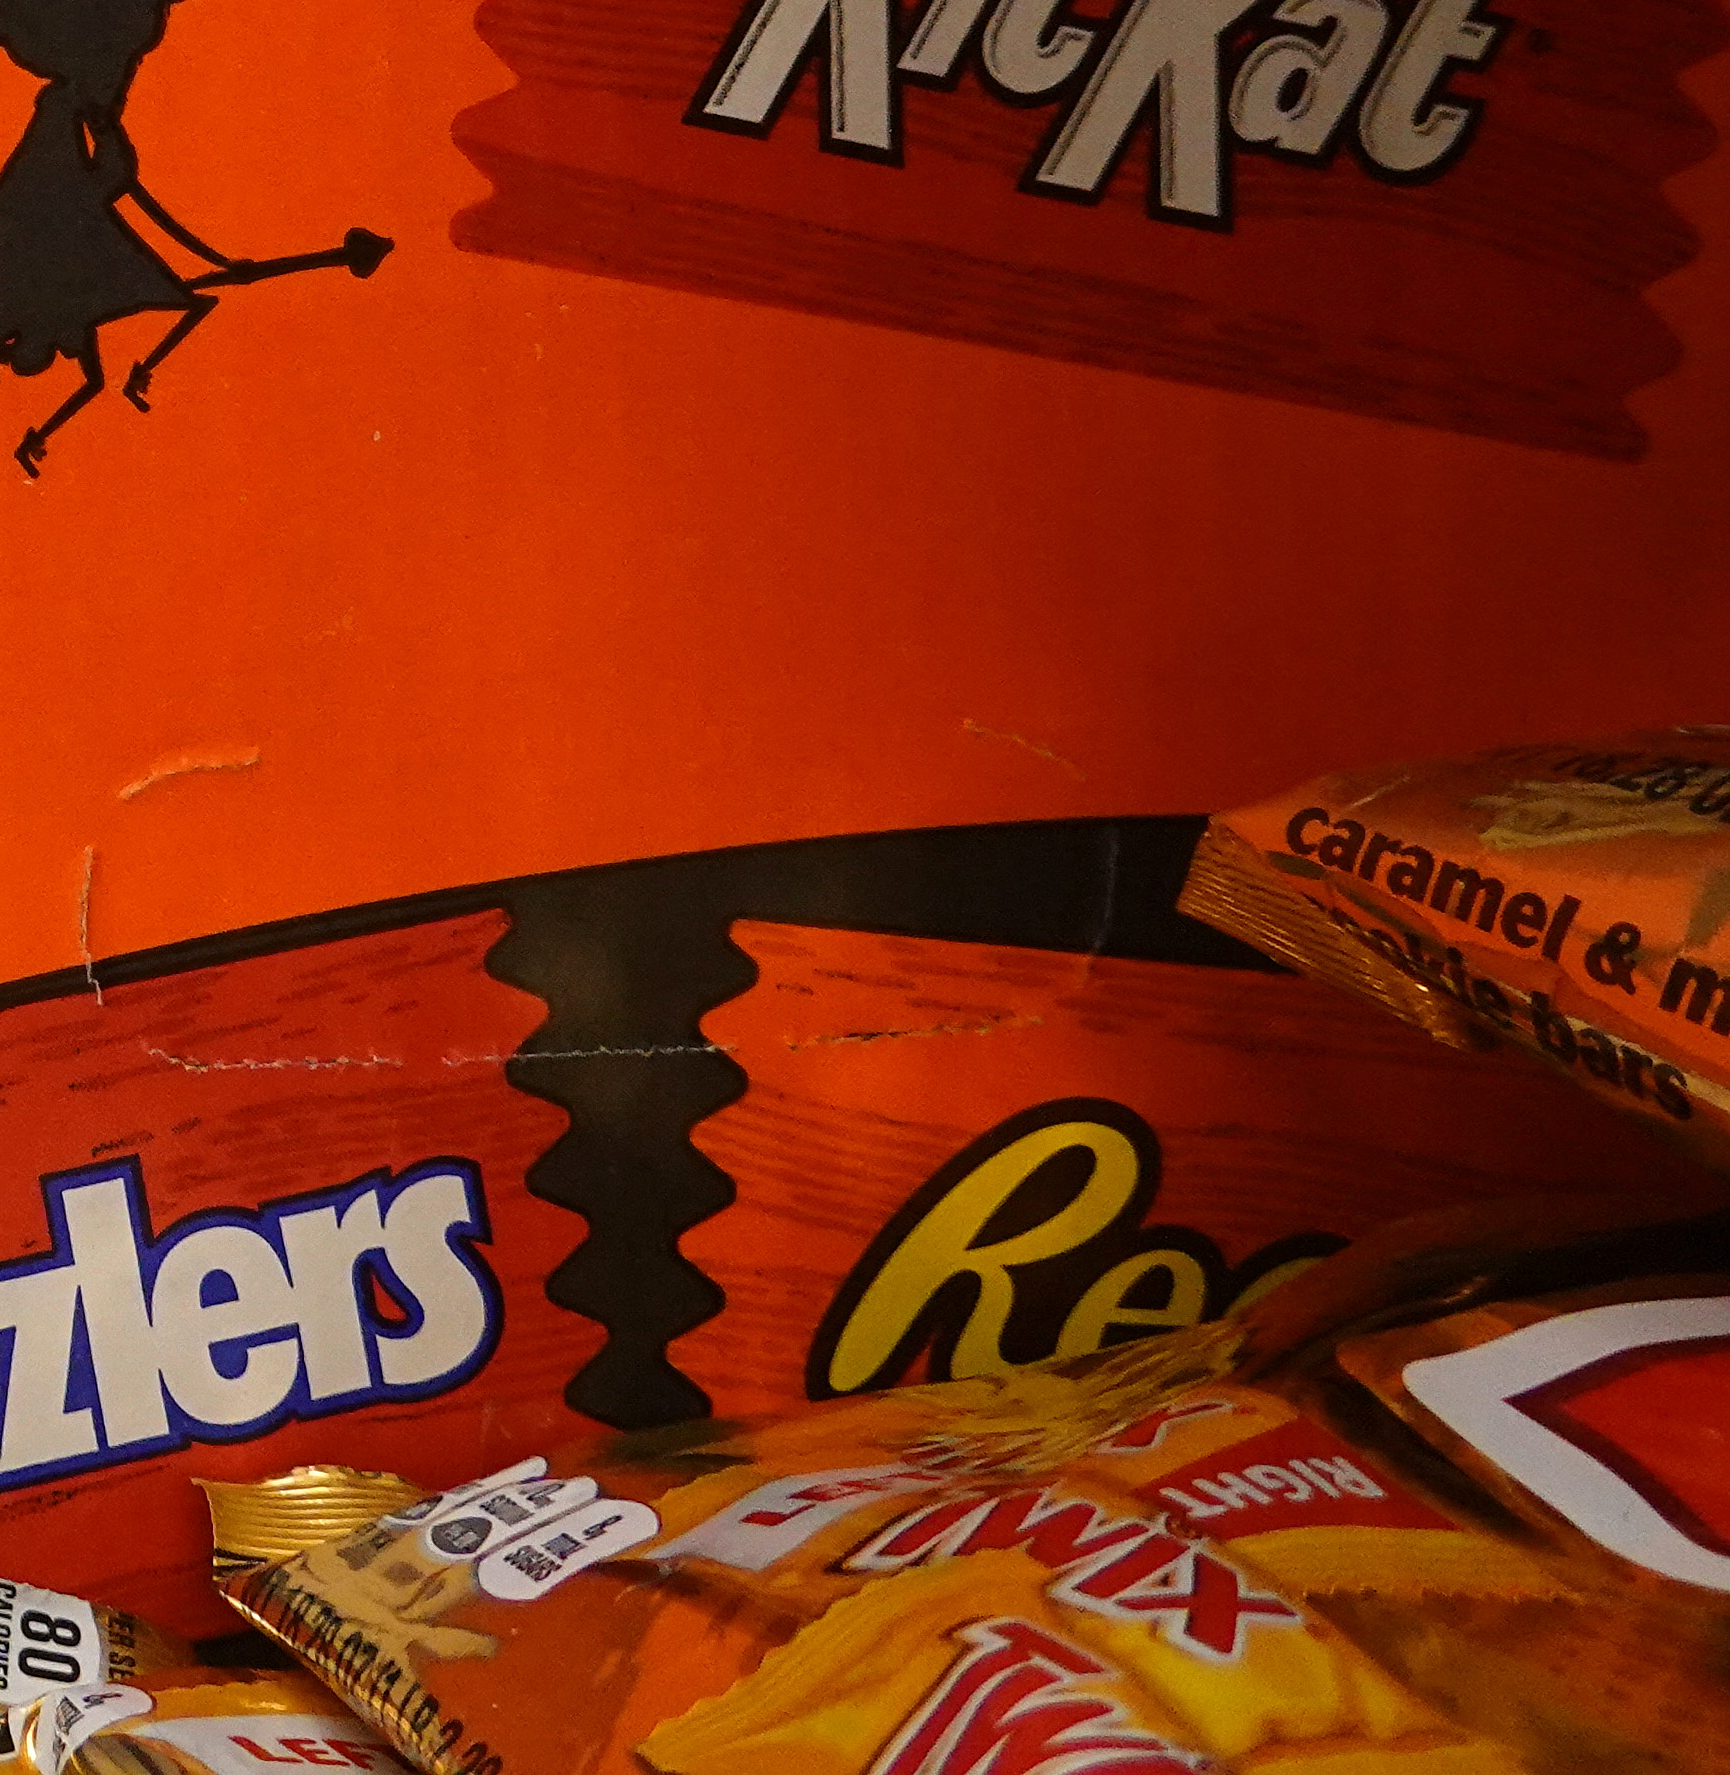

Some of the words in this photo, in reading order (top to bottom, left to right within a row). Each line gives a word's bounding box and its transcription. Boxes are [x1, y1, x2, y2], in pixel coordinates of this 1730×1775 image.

[1285, 807, 1581, 963] caramel
[1584, 922, 1643, 995] &
[1530, 990, 1693, 1121] bars
[1160, 1455, 1386, 1519] RIGHT
[18, 1609, 81, 1683] 80
